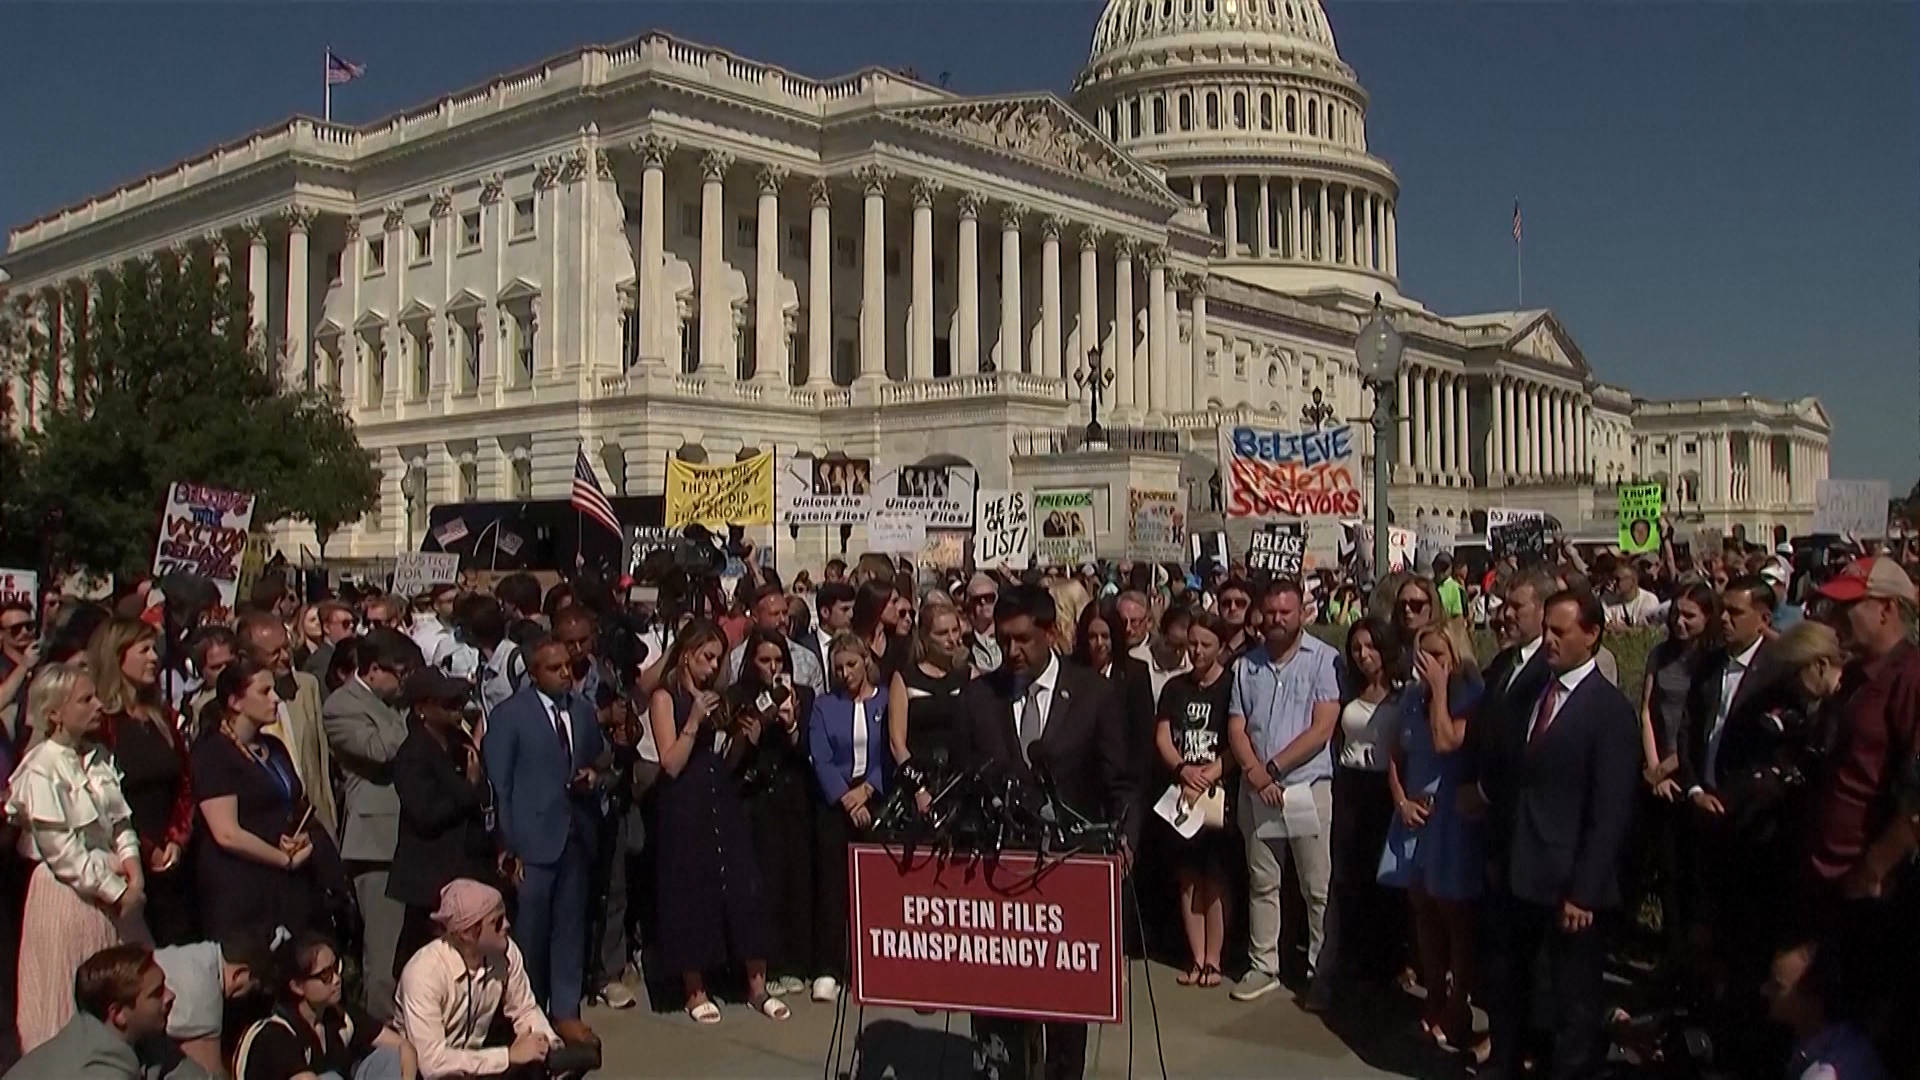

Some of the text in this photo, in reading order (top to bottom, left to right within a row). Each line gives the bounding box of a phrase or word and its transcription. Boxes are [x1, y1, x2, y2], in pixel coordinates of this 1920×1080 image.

[1233, 425, 1353, 467] BELIEVE
[693, 469, 724, 480] WHAT
[1623, 487, 1659, 498] TRUMP
[793, 497, 862, 508] Unlock the
[885, 498, 961, 510] Unlock the
[984, 491, 1024, 520] HE IS
[784, 511, 832, 523] Epstein
[834, 511, 870, 522] Files!
[1252, 532, 1303, 557] RELEASE
[903, 896, 1063, 934] EPSTEIN FILES
[869, 928, 1100, 972] TRANSPARENCY ACT
